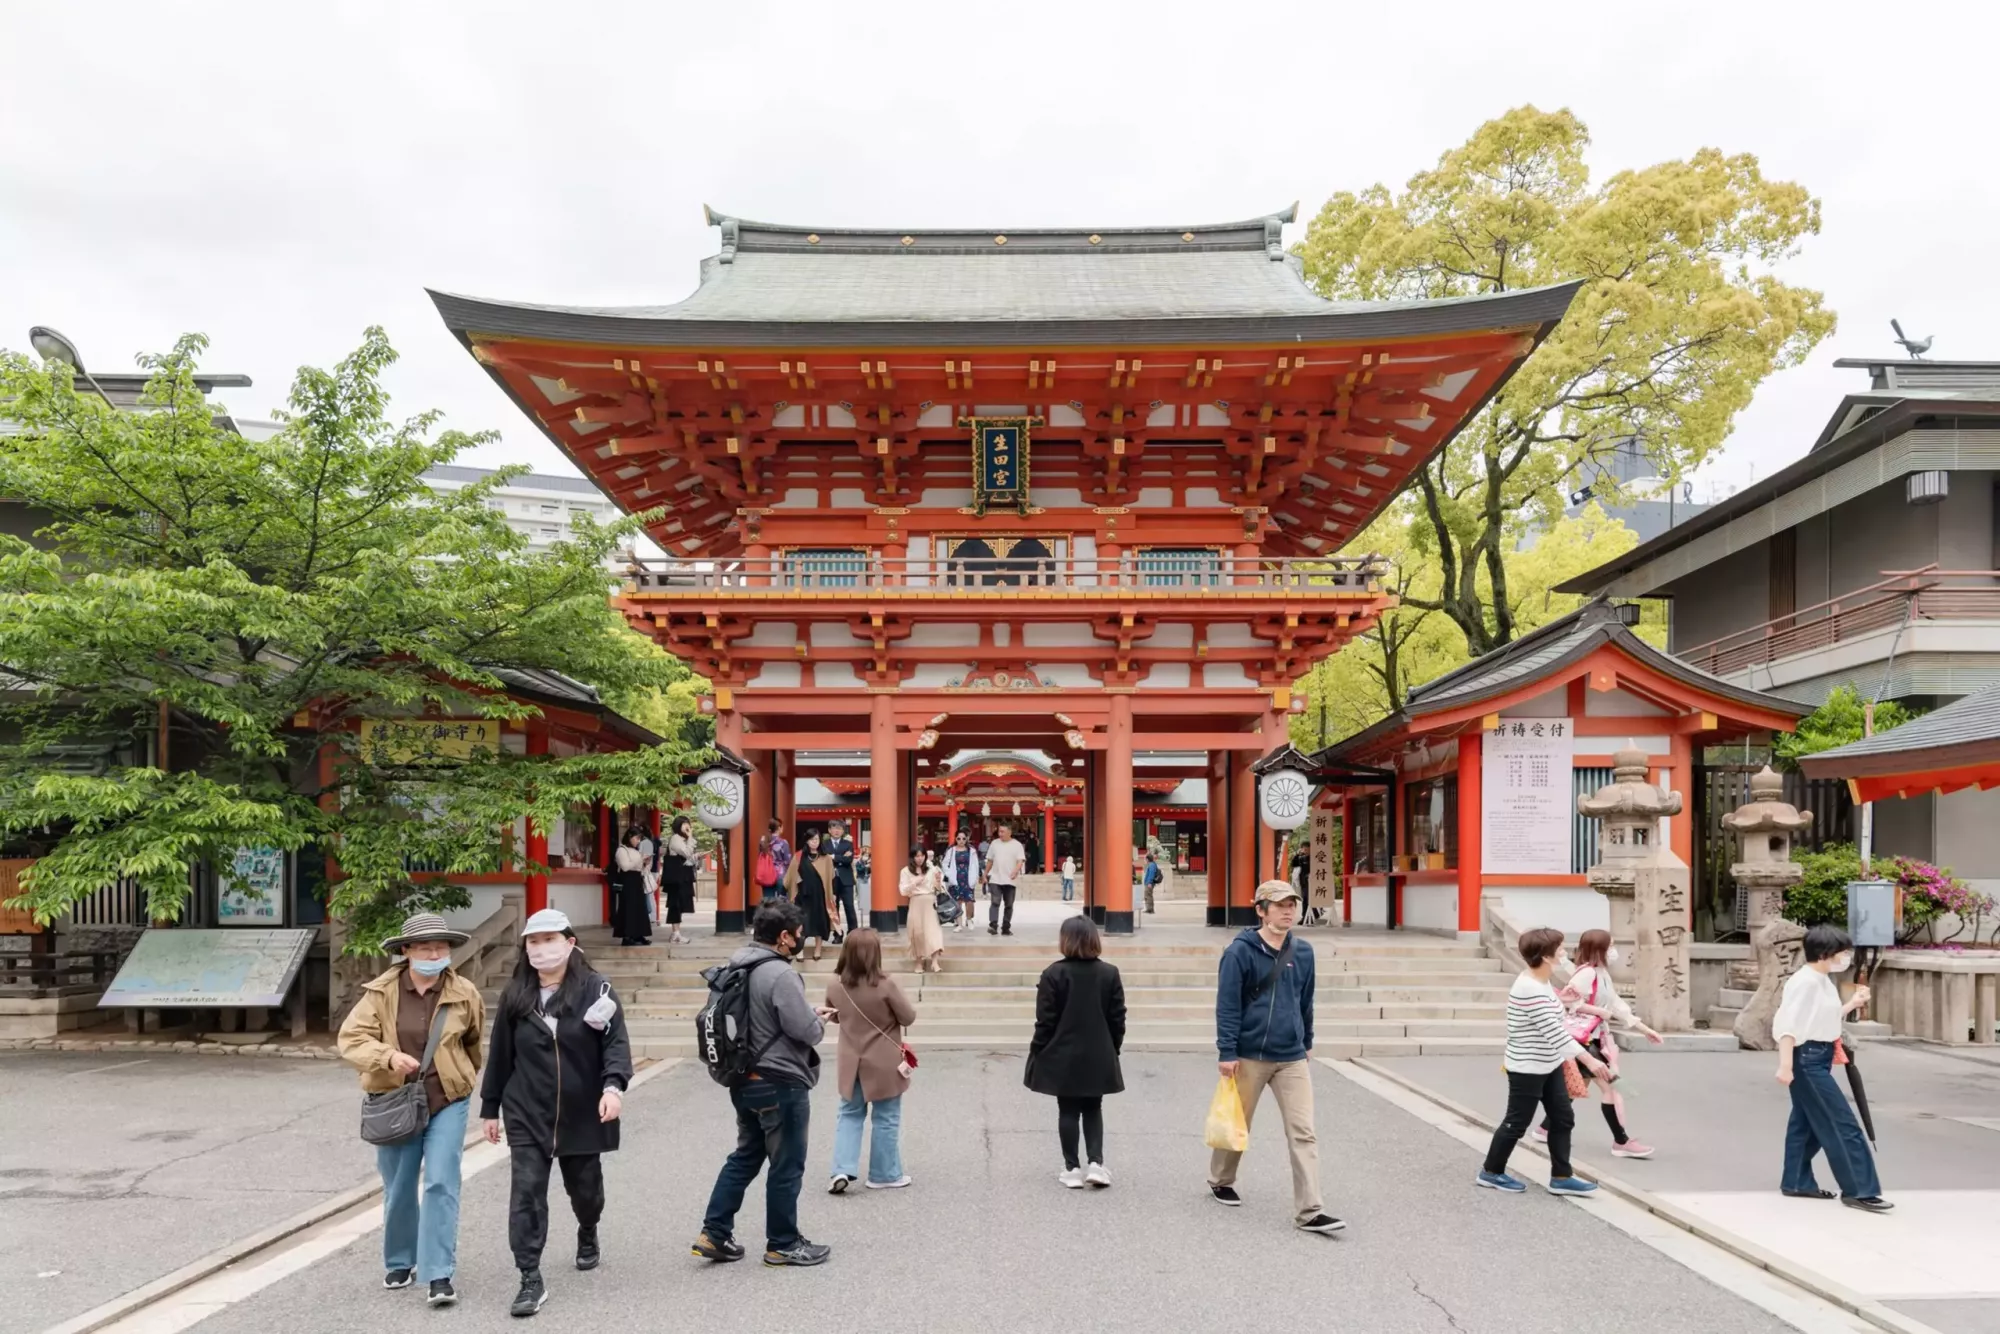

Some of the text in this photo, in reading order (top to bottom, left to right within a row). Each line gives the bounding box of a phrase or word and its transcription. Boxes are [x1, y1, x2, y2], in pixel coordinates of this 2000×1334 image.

[992, 433, 1011, 486] 生田宮
[1314, 816, 1329, 899] 祈祷受付所
